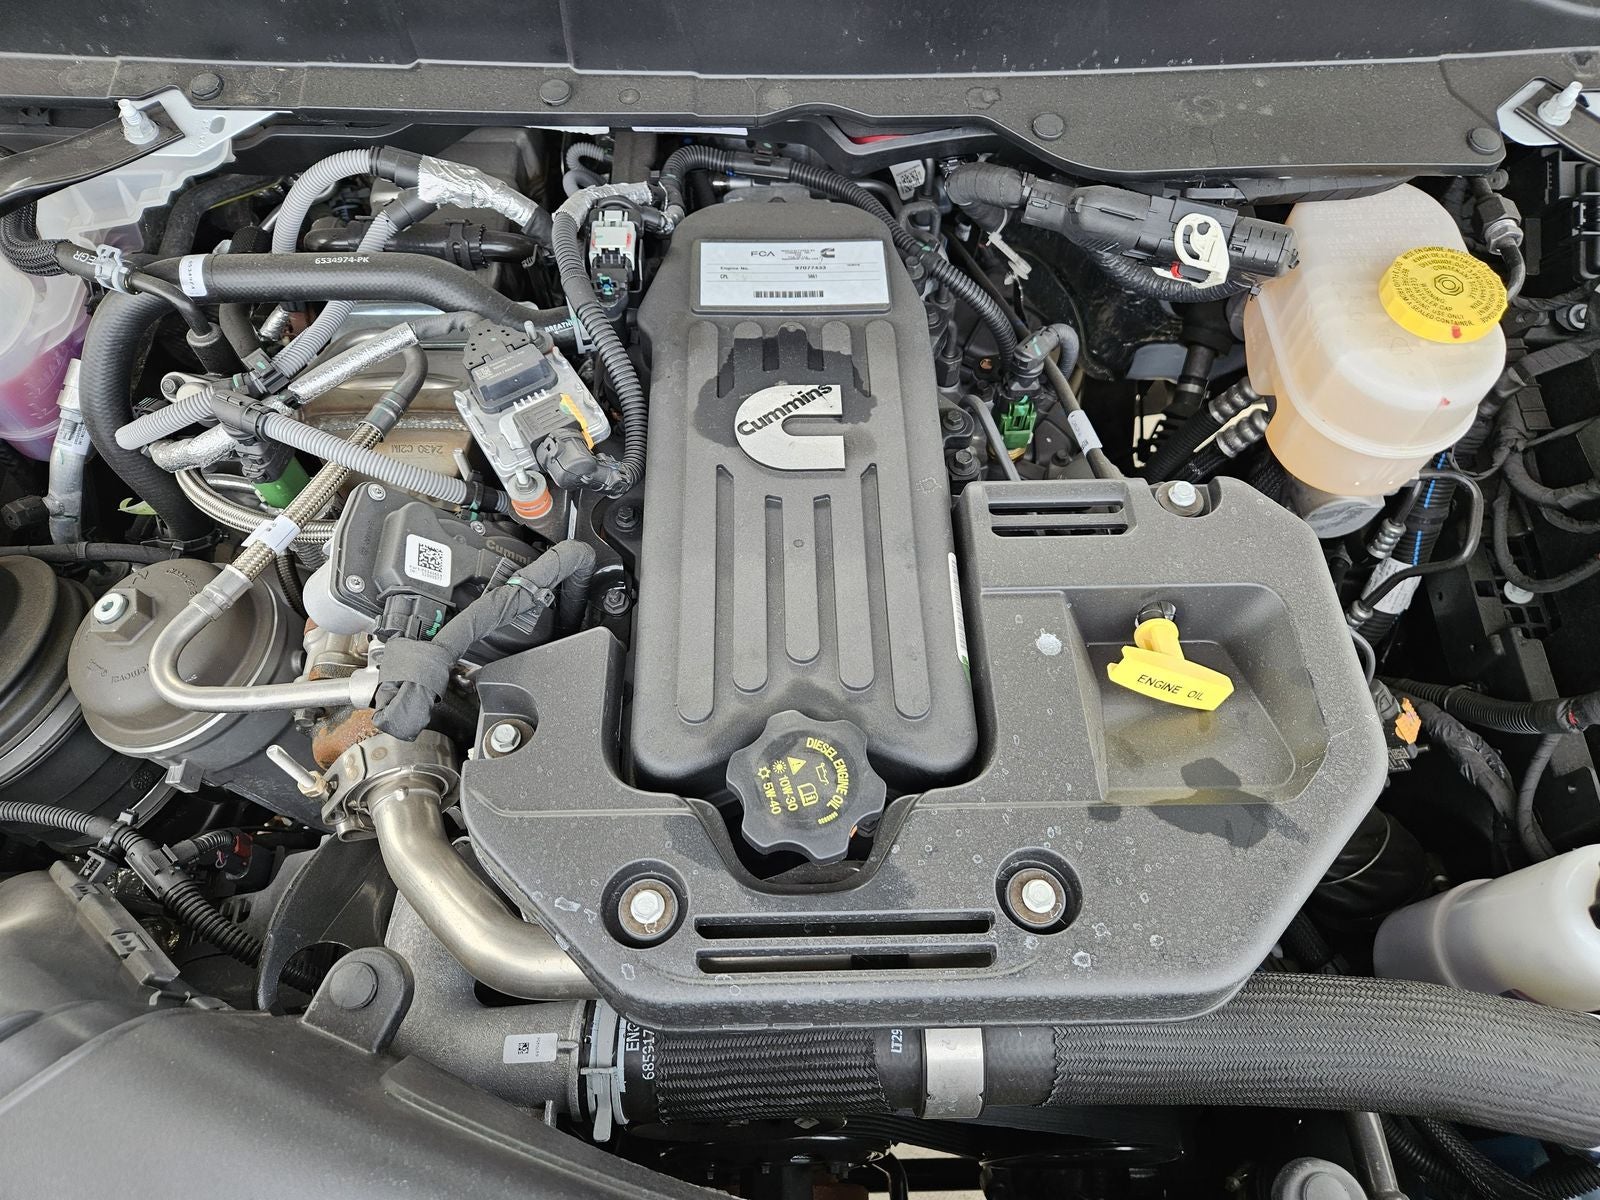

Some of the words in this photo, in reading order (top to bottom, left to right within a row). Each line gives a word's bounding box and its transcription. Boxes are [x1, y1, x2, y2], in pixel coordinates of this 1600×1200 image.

[314, 256, 369, 264] 6534974-PK
[1439, 304, 1453, 312] CAP
[737, 384, 832, 435] Cummins
[1137, 674, 1182, 694] ENGINE
[1187, 690, 1204, 701] OIL
[806, 737, 838, 761] DIESEL
[832, 758, 849, 796] ENGINE
[763, 782, 781, 814] 5W-40
[778, 775, 798, 811] 10W-30
[826, 794, 843, 810] OIL
